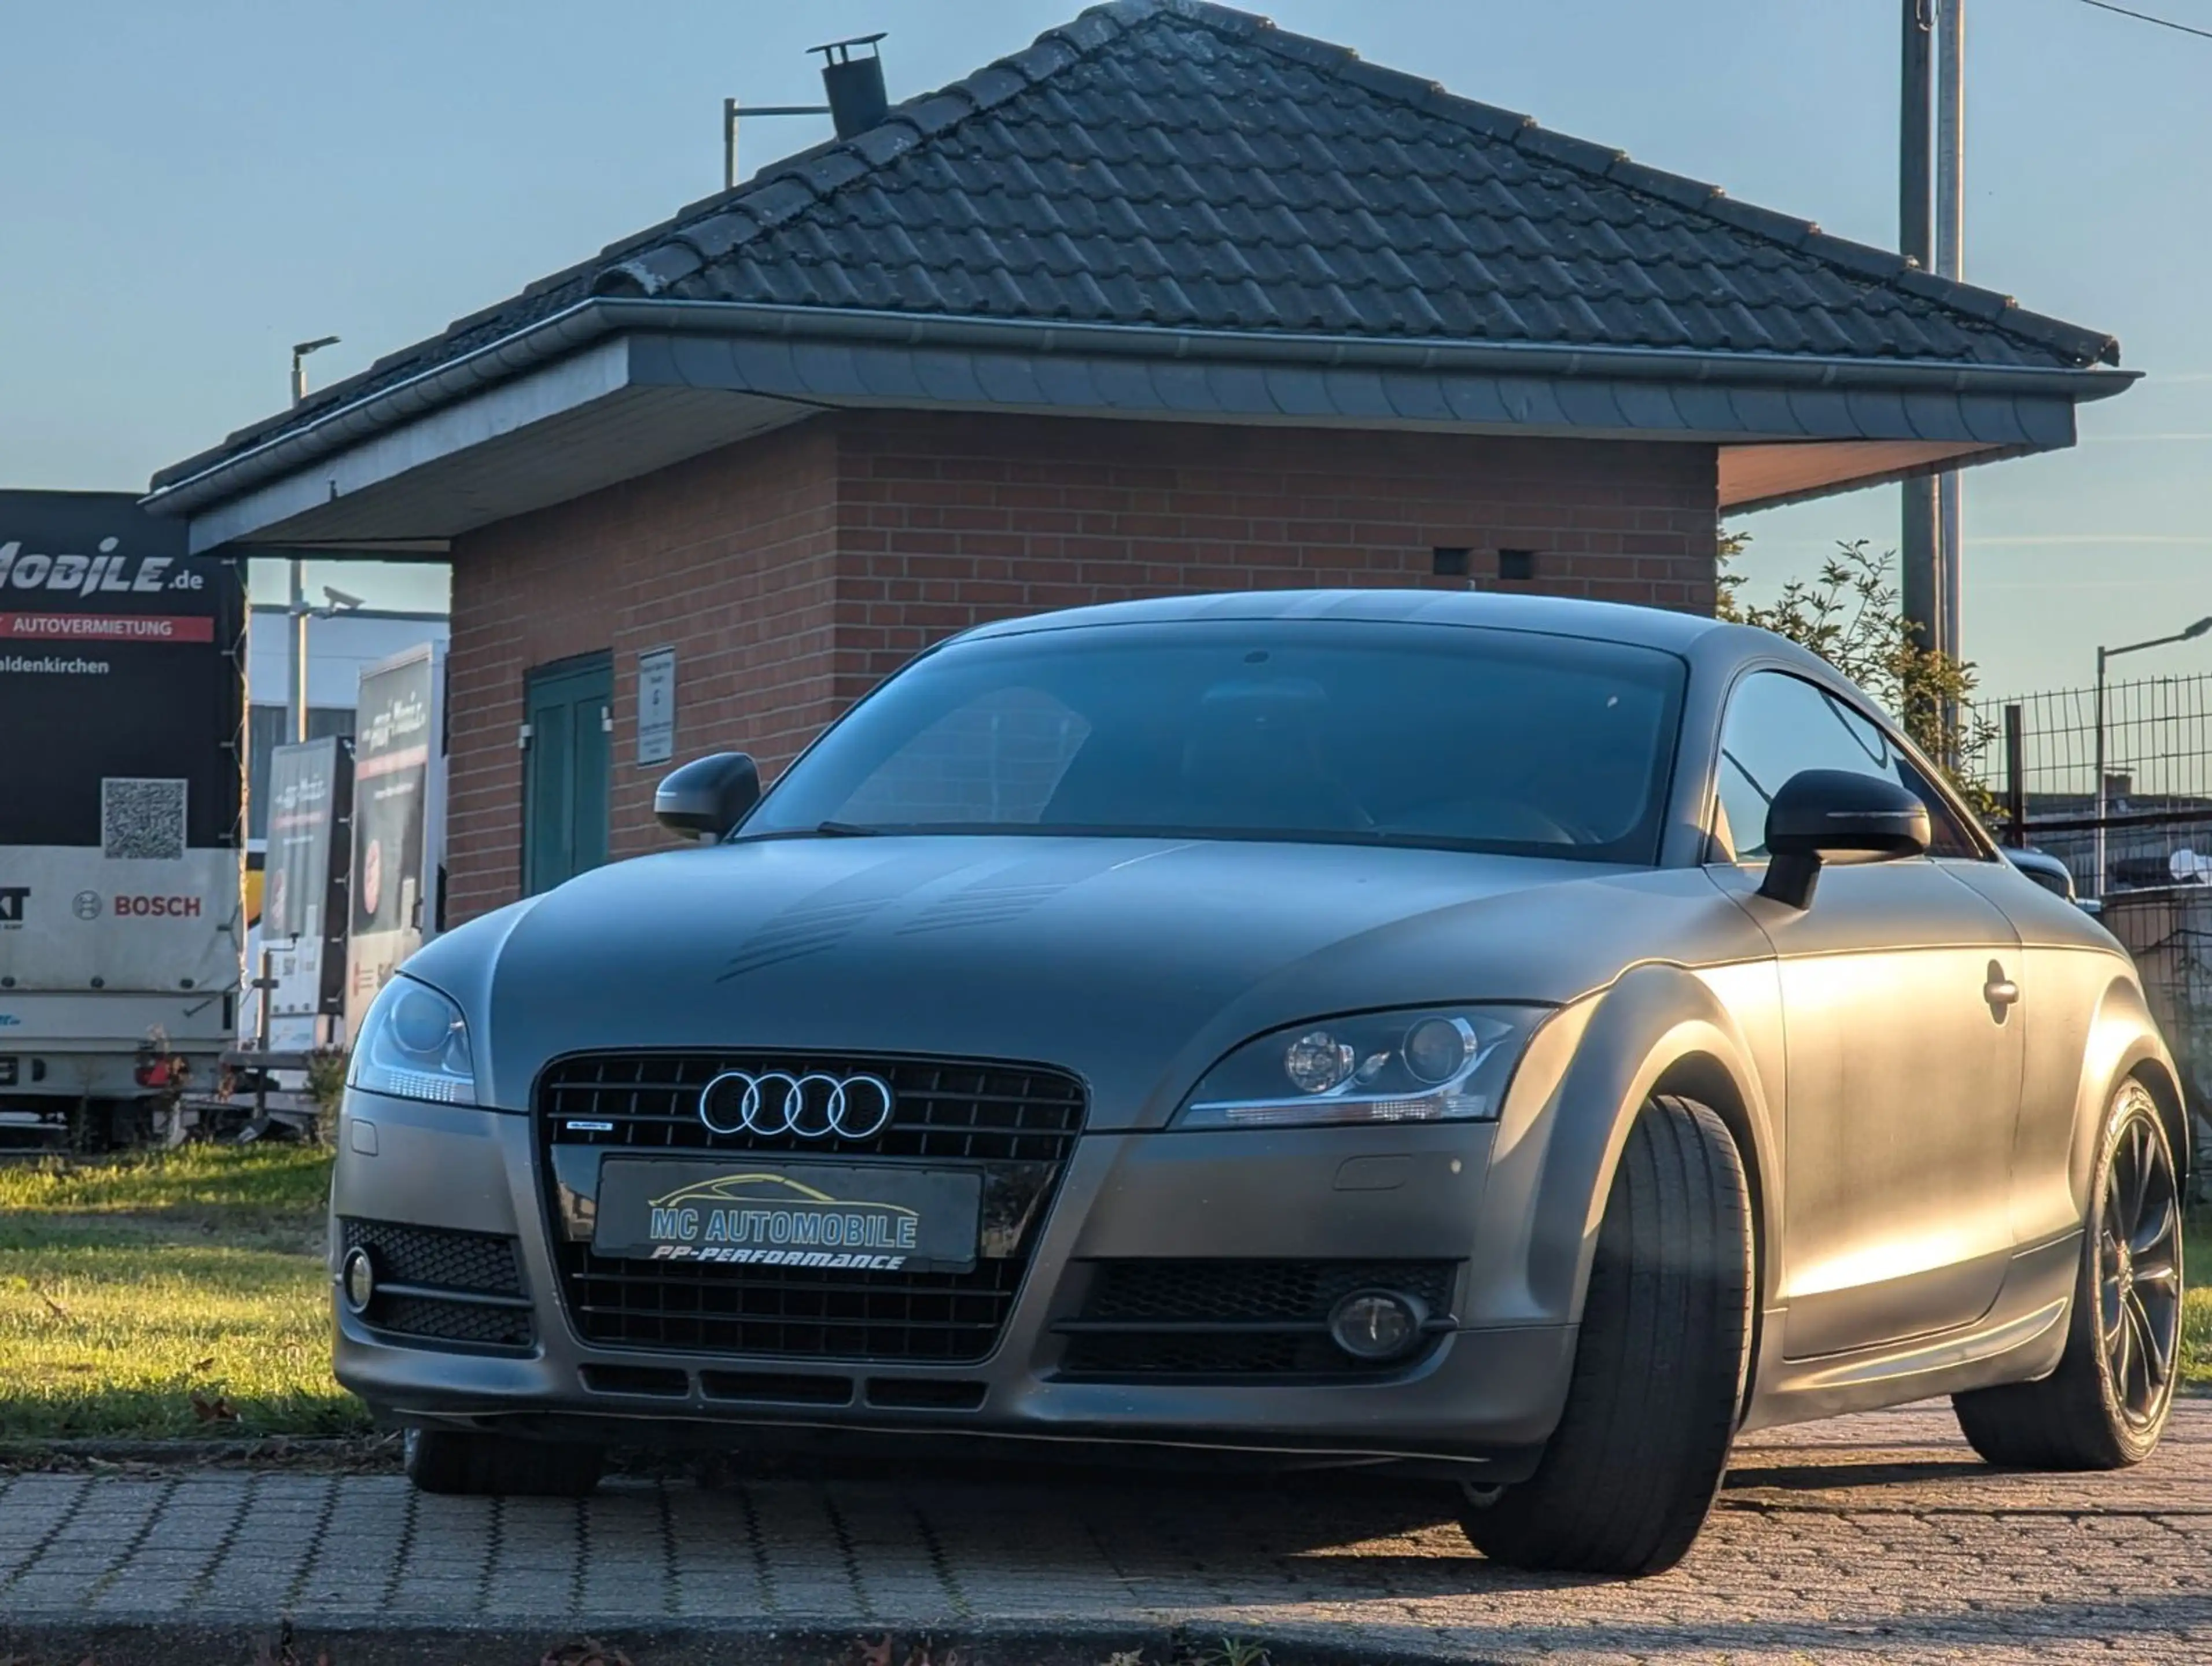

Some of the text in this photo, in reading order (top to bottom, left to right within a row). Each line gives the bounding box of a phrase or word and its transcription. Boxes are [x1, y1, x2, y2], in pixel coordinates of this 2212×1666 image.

[13, 617, 173, 636] AUTOVERMIETUNG
[115, 896, 201, 917] BOSCH
[650, 1208, 918, 1249] MC AUTOMOBILE
